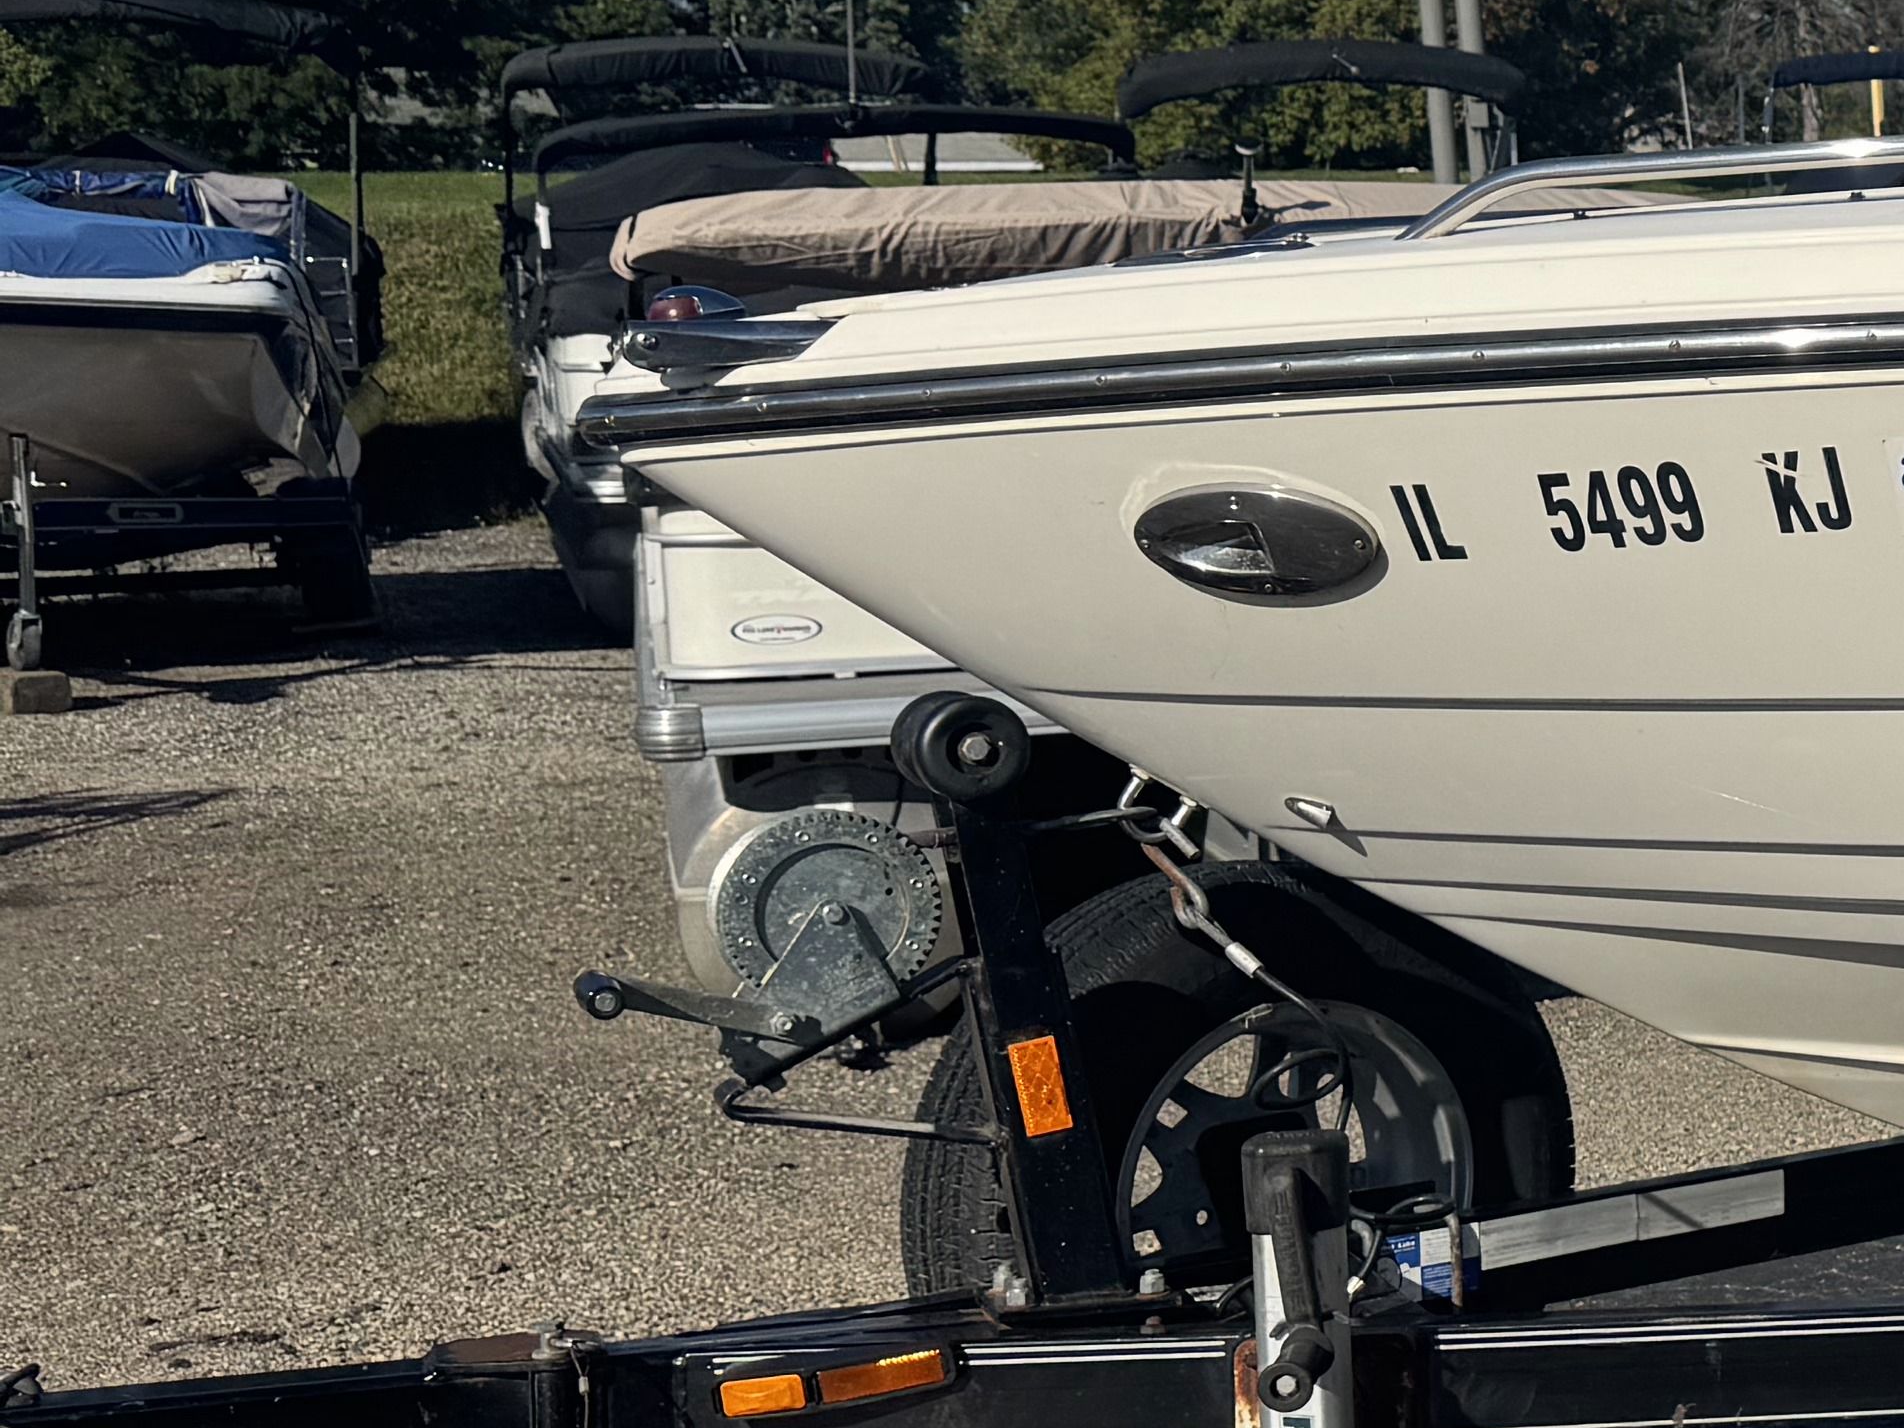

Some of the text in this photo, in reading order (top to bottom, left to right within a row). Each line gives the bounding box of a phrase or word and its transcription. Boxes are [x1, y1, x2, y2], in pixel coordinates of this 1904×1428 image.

[1389, 446, 1853, 561] IL 5499 KJ
